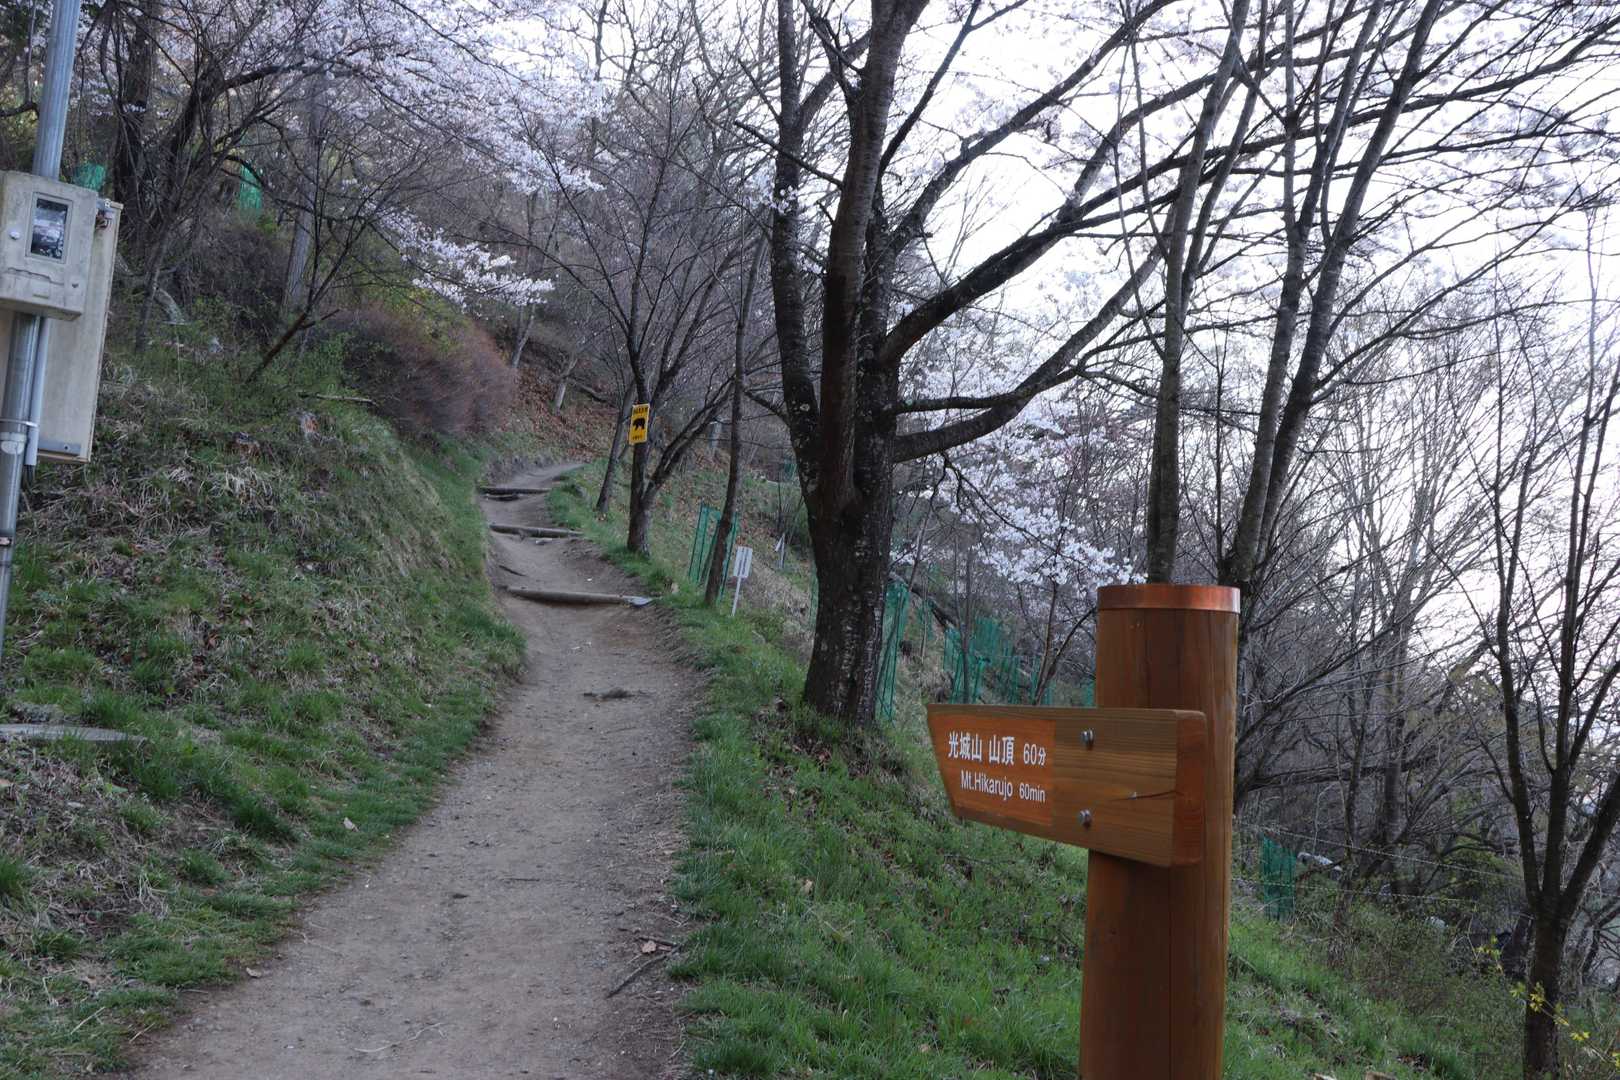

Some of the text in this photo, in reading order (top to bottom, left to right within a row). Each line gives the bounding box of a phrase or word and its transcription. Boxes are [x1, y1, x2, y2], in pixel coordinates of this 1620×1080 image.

[948, 730, 1046, 766] 光城山 山頂 60分
[961, 769, 1045, 803] Mt.Hikarujo 60min
